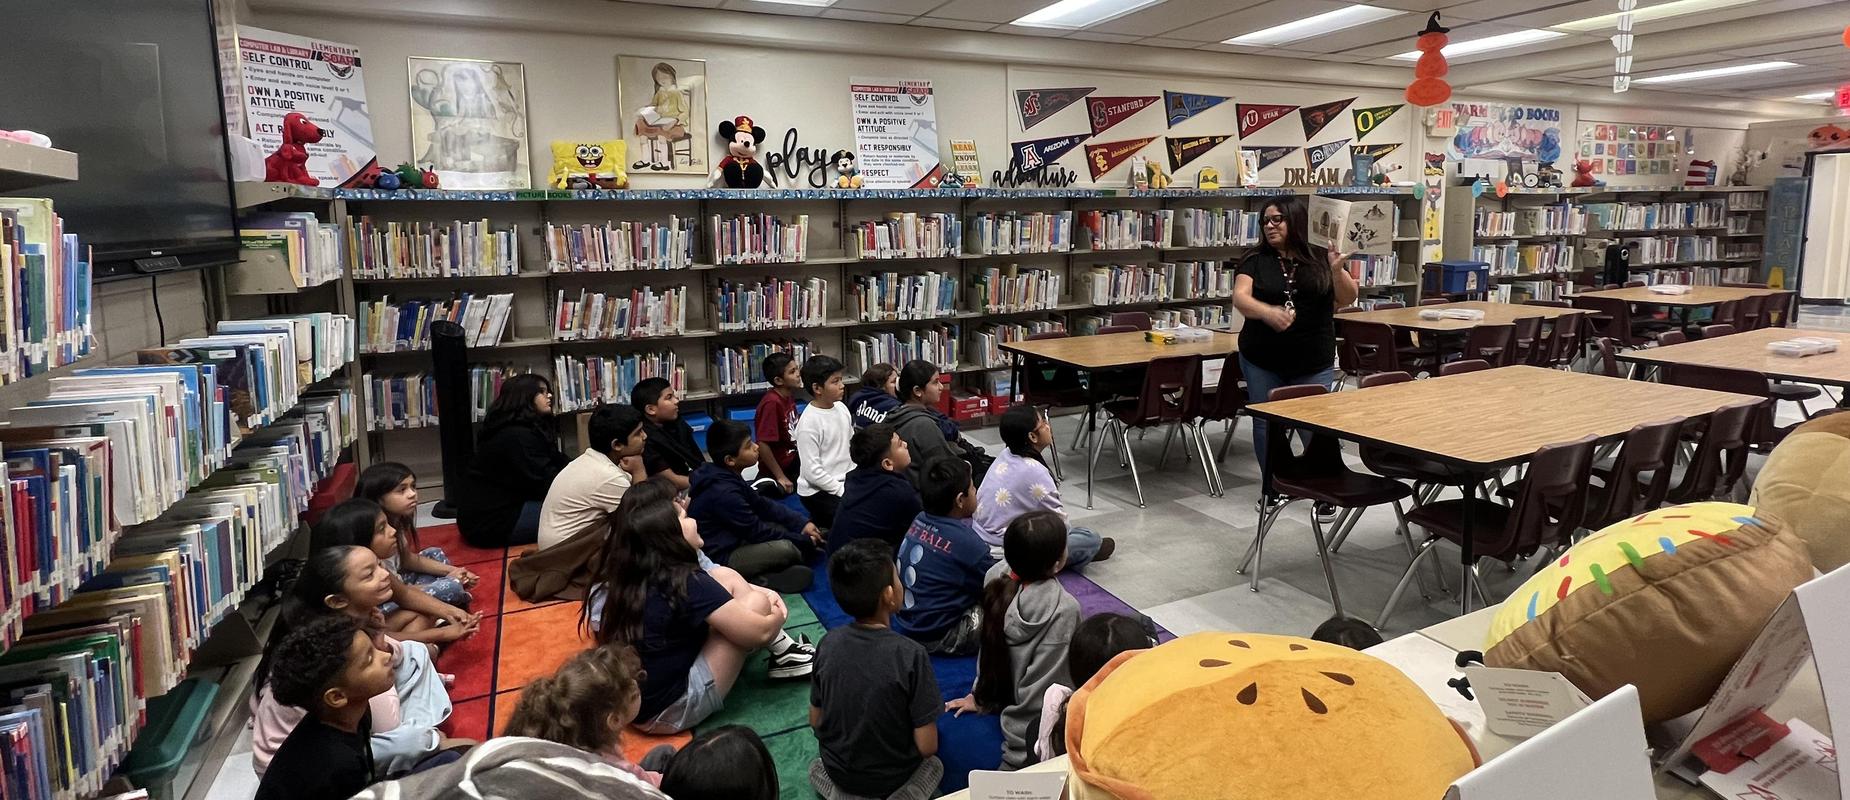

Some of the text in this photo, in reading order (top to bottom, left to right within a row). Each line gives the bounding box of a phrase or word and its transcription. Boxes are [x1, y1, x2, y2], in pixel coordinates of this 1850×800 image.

[311, 42, 355, 55] ELEMENTARY
[242, 51, 313, 71] SELF CONTROL
[247, 85, 325, 103] OWN A POSITIVE
[854, 93, 899, 103] SELF CONTROL
[251, 97, 295, 110] ATTITUDE
[1107, 99, 1144, 116] STANFORD
[1262, 110, 1279, 120] UTAH
[1452, 103, 1488, 117] WARM
[1526, 108, 1559, 121] BOOKS
[857, 117, 871, 125] OWN
[879, 118, 906, 126] POSITIVE
[255, 123, 274, 134] ACT
[857, 125, 886, 133] ATTITUDE
[860, 143, 912, 152] ACT RESPONSIBLY
[1043, 138, 1070, 154] ARIZONA
[766, 128, 834, 188] play
[861, 169, 889, 177] RESPECT
[1282, 167, 1340, 188] DREAM
[516, 191, 572, 199] PICTURE BOOKS
[919, 529, 952, 554] BALL
